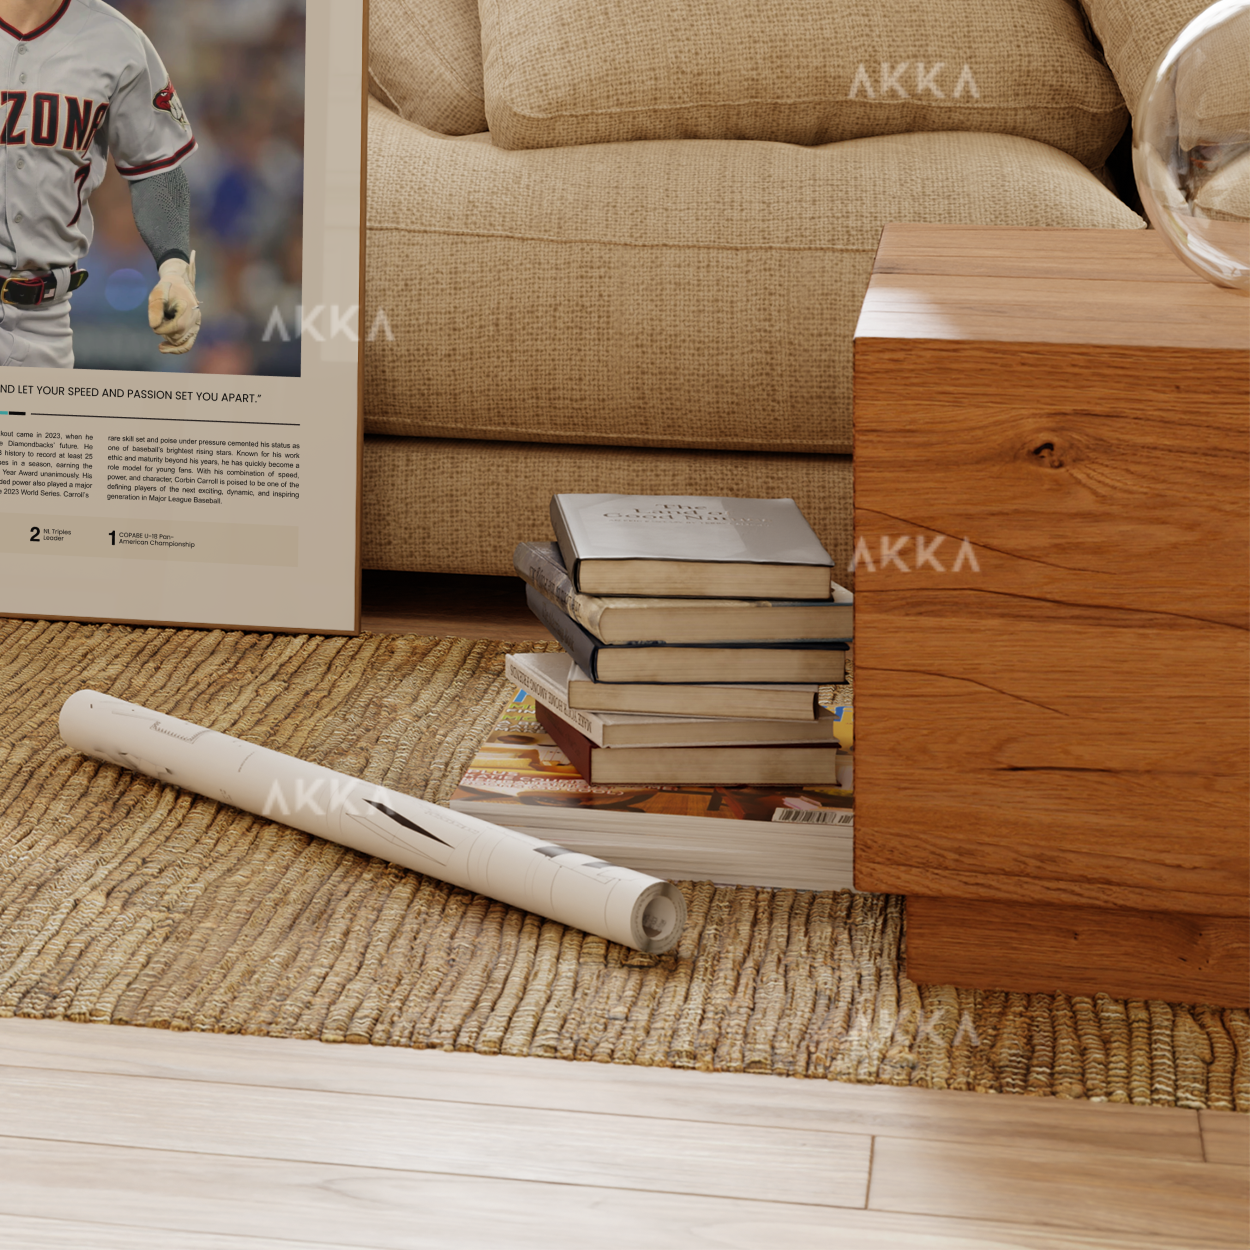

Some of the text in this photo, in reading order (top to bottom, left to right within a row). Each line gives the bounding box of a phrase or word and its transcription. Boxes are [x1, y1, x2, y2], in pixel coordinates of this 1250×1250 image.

[17, 384, 34, 394] LET
[36, 385, 64, 395] YOUR
[67, 386, 99, 397] SPEED
[101, 388, 124, 397] AND
[127, 389, 172, 400] PASSION
[175, 390, 193, 400] SET
[195, 391, 218, 401] YOU
[198, 439, 226, 447] pressure
[227, 439, 258, 447] cemented
[29, 526, 40, 542] 2
[51, 528, 71, 536] Triples
[108, 530, 115, 545] 1
[149, 539, 195, 549] Championship
